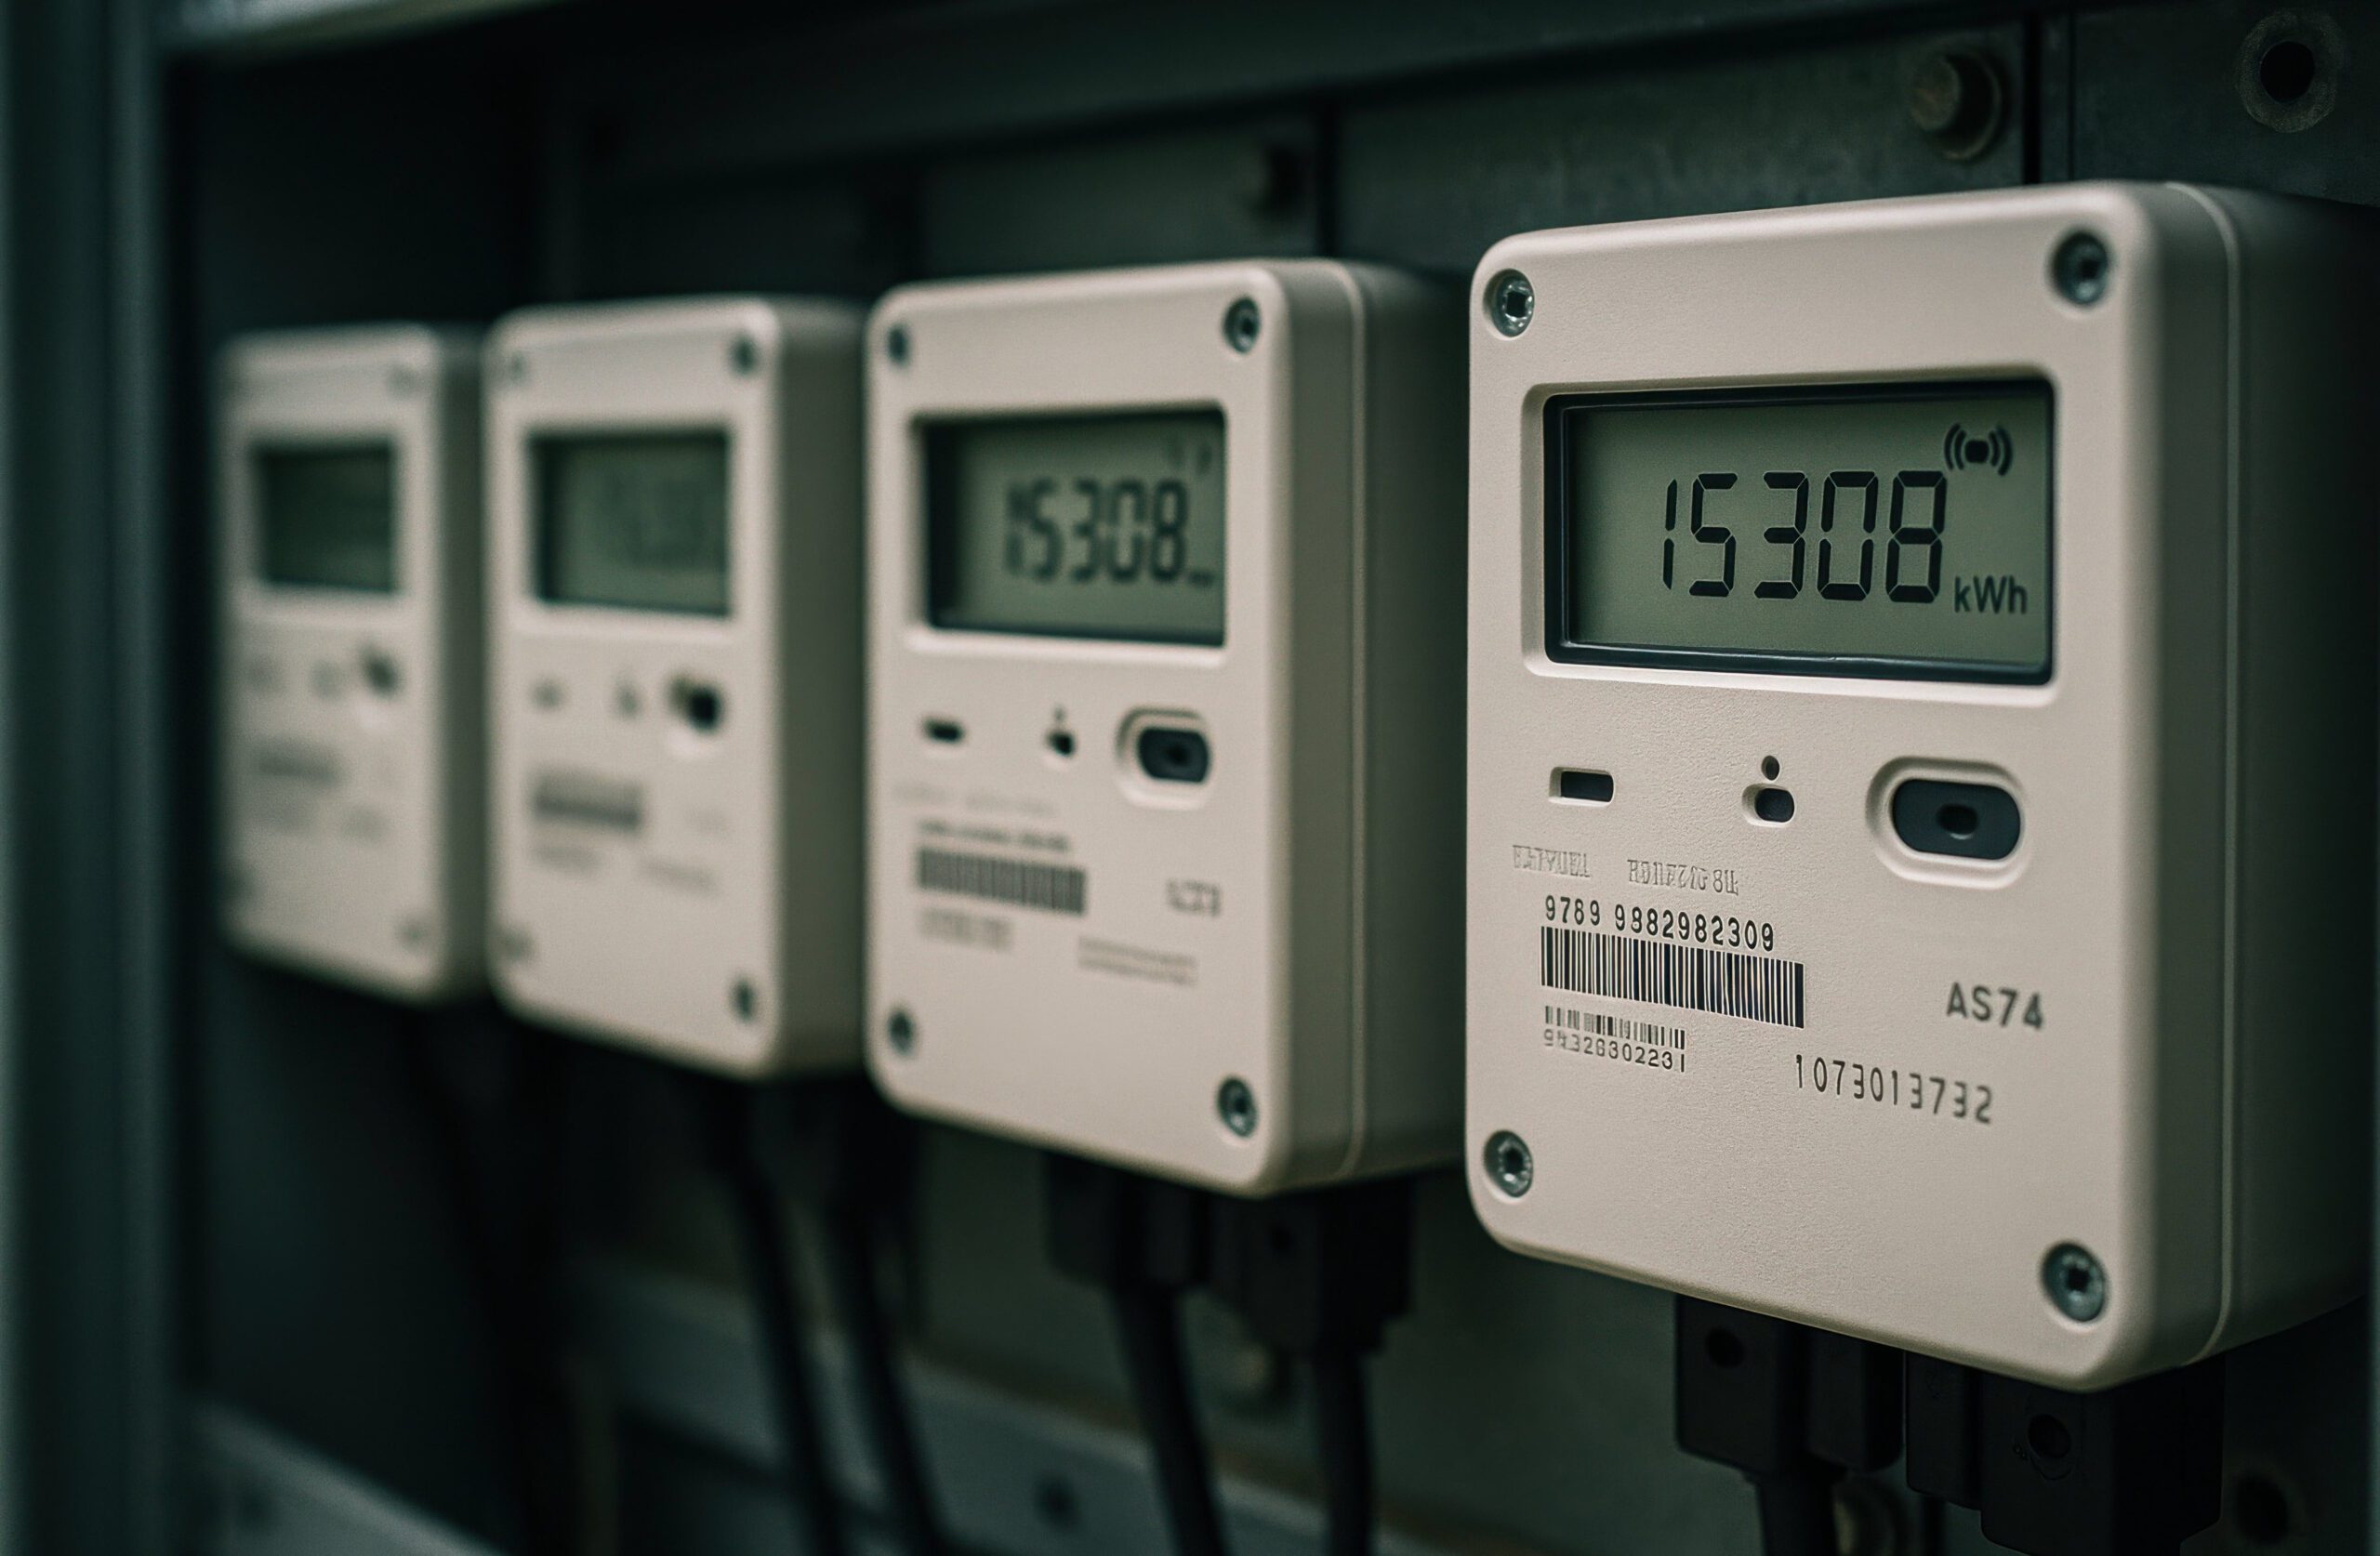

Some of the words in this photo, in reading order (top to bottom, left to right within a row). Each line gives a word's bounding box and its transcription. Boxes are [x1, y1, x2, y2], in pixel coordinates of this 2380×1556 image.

[1006, 477, 1188, 585] 15308
[1663, 470, 1948, 602] 15308
[1954, 575, 2028, 613] kWh
[1545, 895, 1600, 926] 9789
[1615, 904, 1774, 951] 9882982309
[1947, 982, 2043, 1030] AS74
[1796, 1054, 1992, 1124] 1073013732
